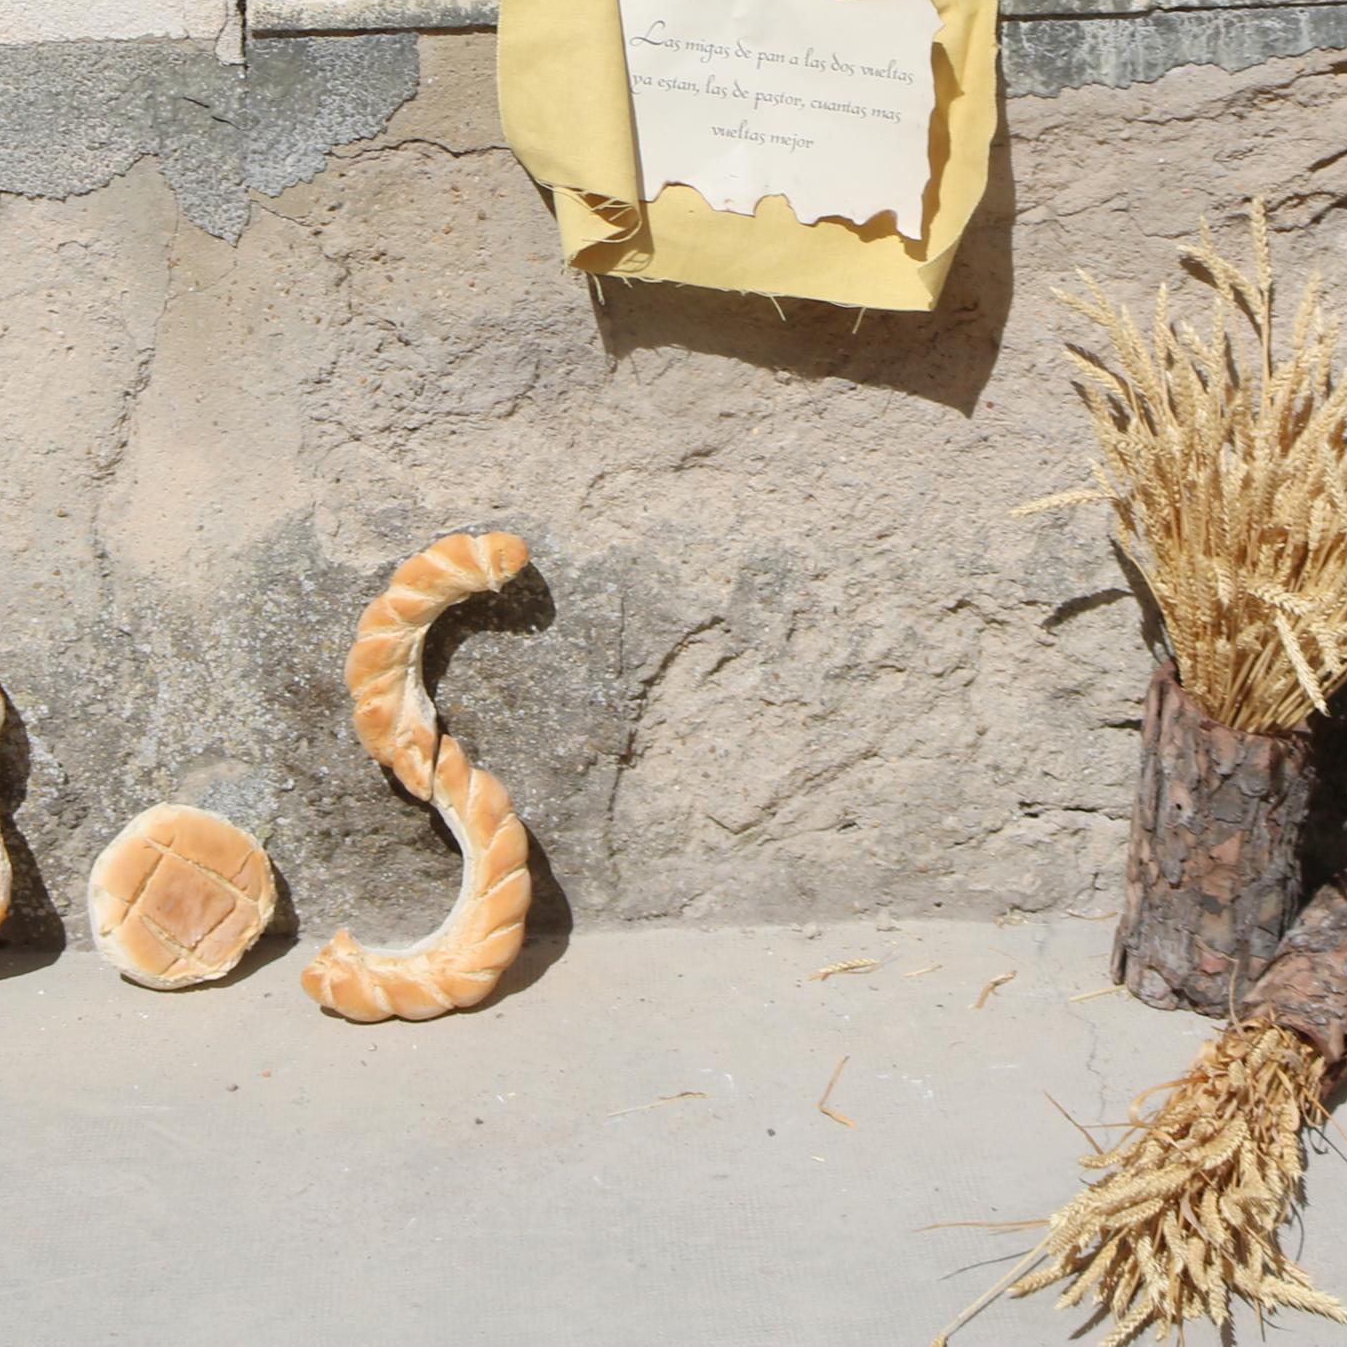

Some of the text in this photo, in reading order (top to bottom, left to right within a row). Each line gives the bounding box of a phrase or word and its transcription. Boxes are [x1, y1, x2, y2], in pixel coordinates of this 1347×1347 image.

[629, 20, 914, 85] Las migas de pan a las dos vueltas
[630, 74, 652, 94] ya
[705, 74, 728, 100] las
[732, 79, 749, 99] de
[810, 99, 867, 119] cuantas
[871, 109, 901, 124] mas
[710, 120, 814, 152] vueltas mejor
